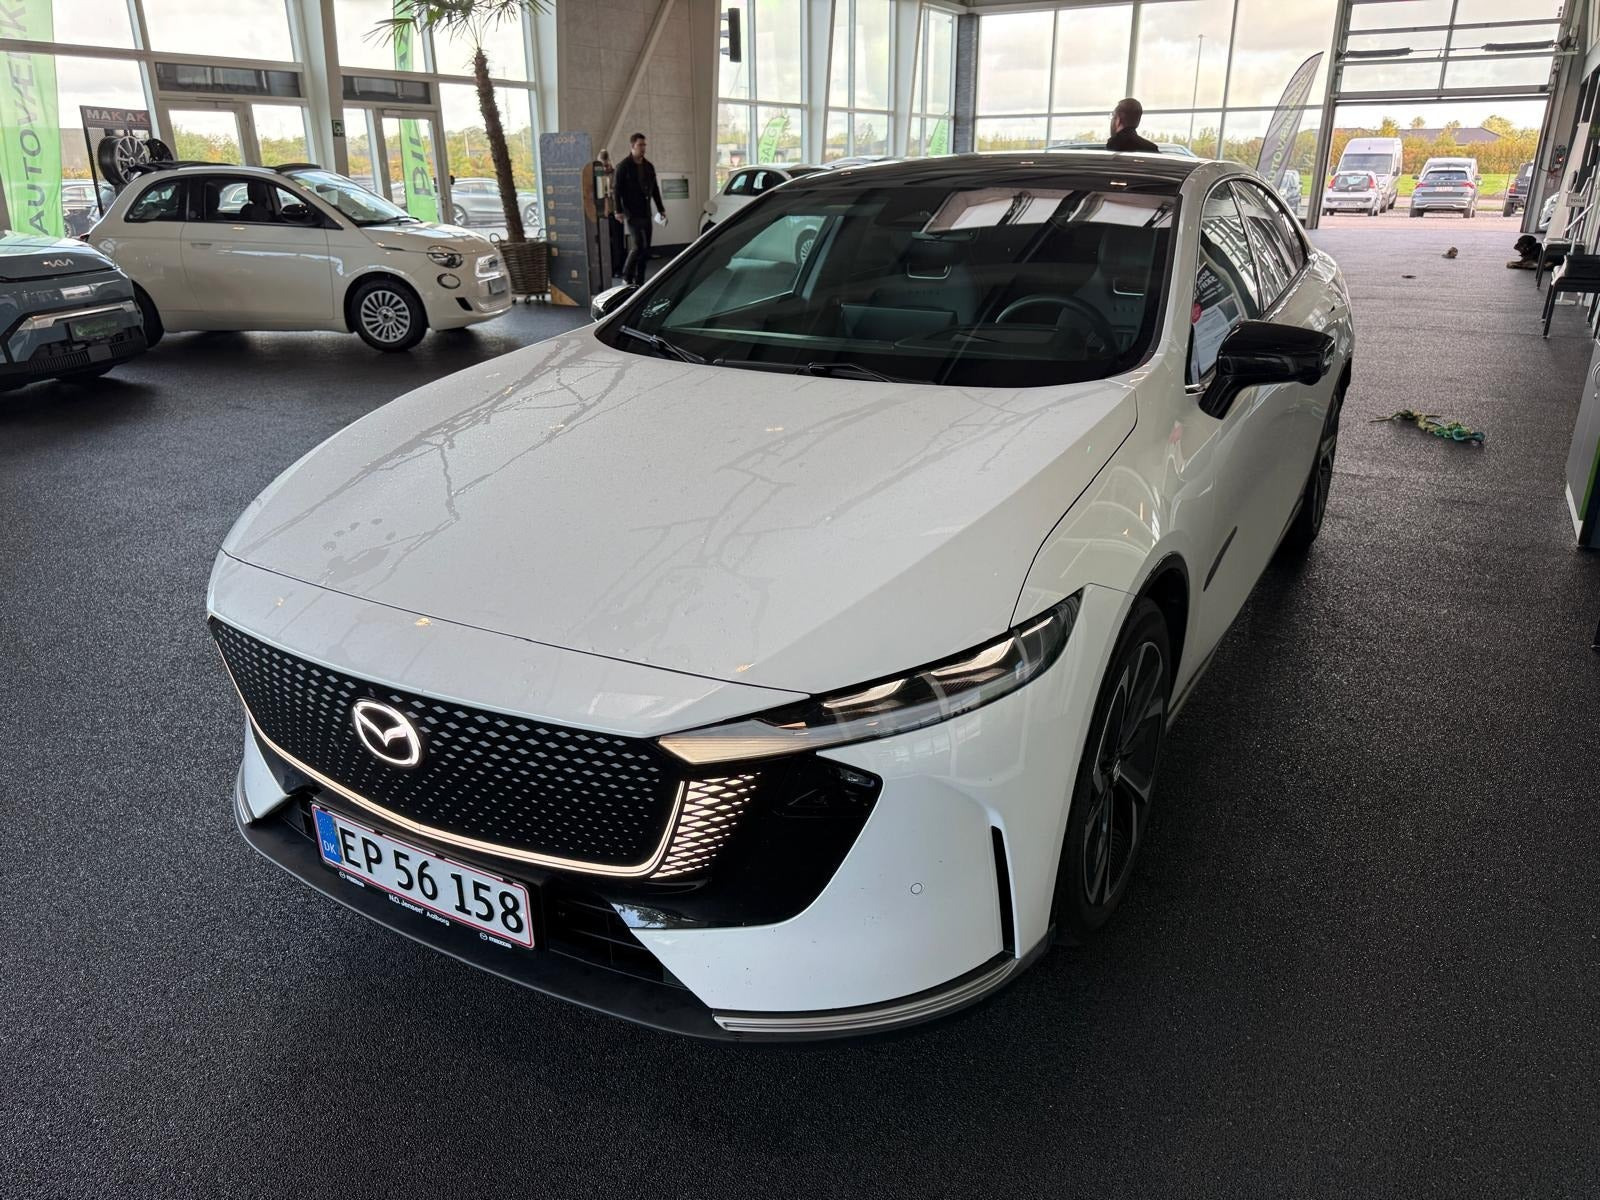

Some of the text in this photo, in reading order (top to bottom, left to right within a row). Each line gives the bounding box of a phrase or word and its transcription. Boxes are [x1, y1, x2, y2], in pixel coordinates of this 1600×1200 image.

[322, 839, 337, 855] DK
[339, 827, 524, 934] EP 56 158
